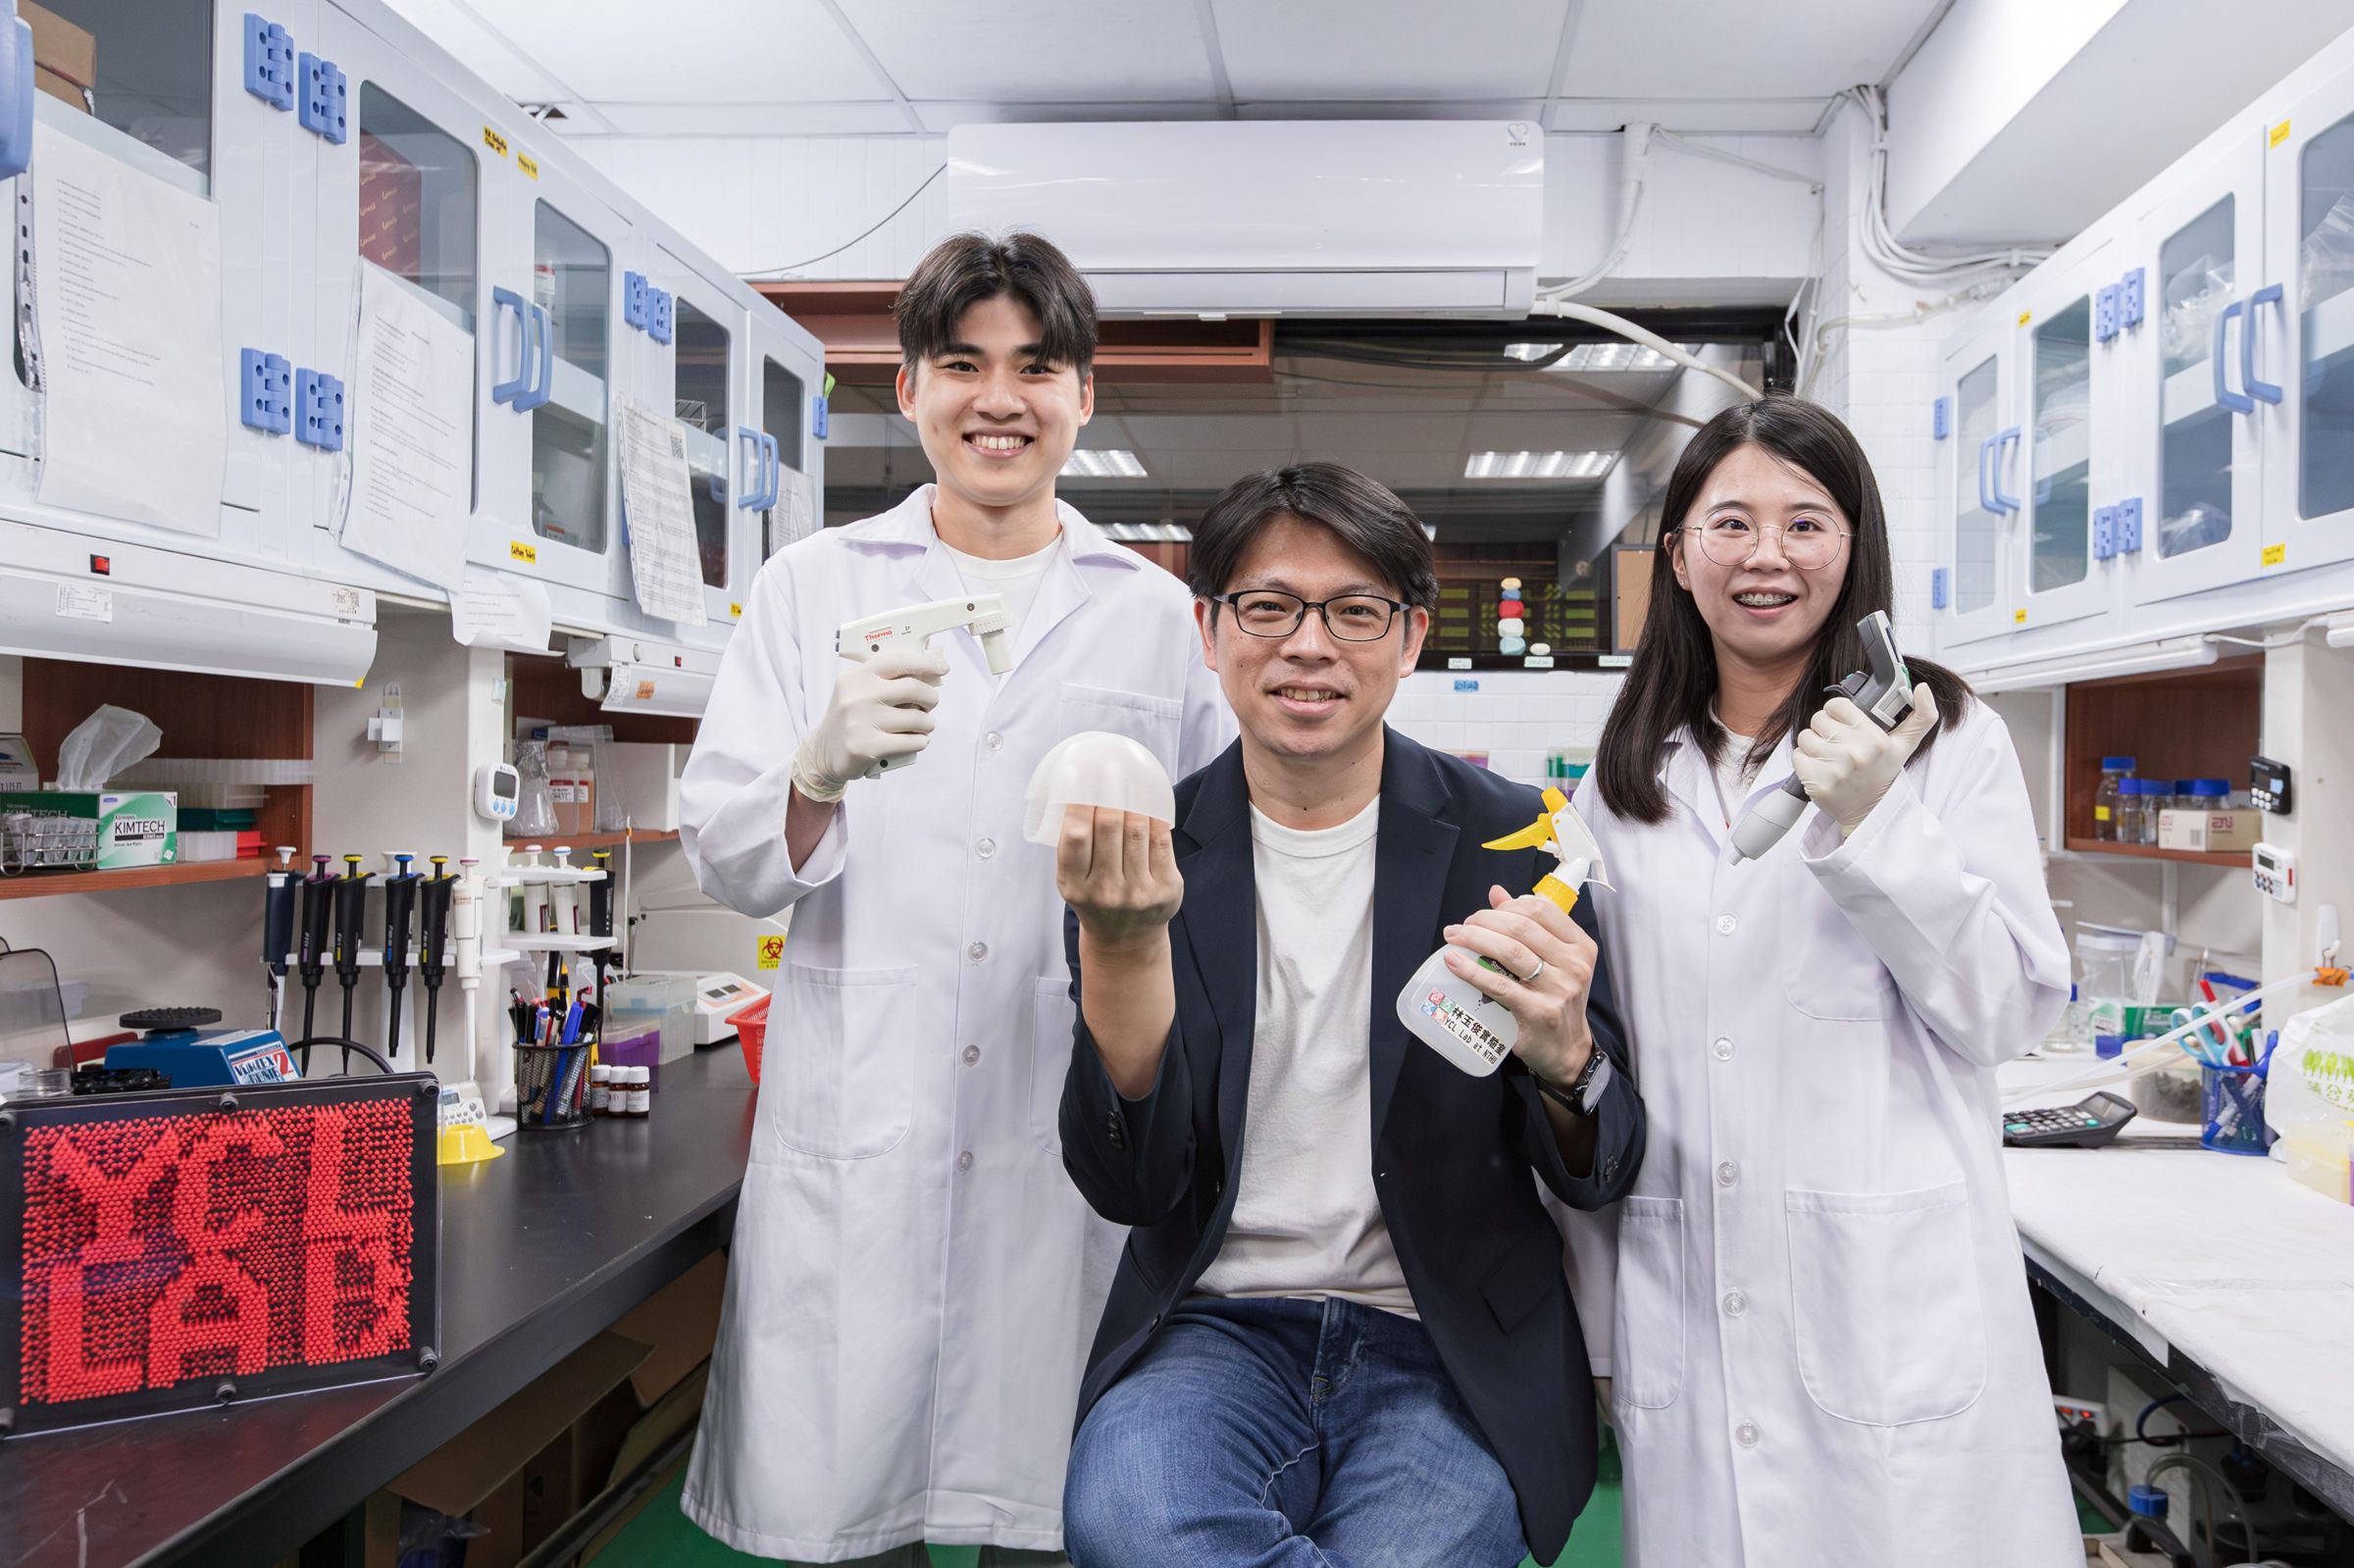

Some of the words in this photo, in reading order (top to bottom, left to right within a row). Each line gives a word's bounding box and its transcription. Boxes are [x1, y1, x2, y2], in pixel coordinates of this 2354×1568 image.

[864, 630, 893, 642] Thermo
[115, 820, 166, 834] KIMTECH
[1444, 1017, 1457, 1033] YCL
[1458, 1030, 1472, 1045] Lab
[1472, 1041, 1482, 1053] at
[1482, 1048, 1498, 1065] NTHU
[1452, 1006, 1507, 1056] 林玉俊實驗室
[48, 1105, 394, 1265] YCL
